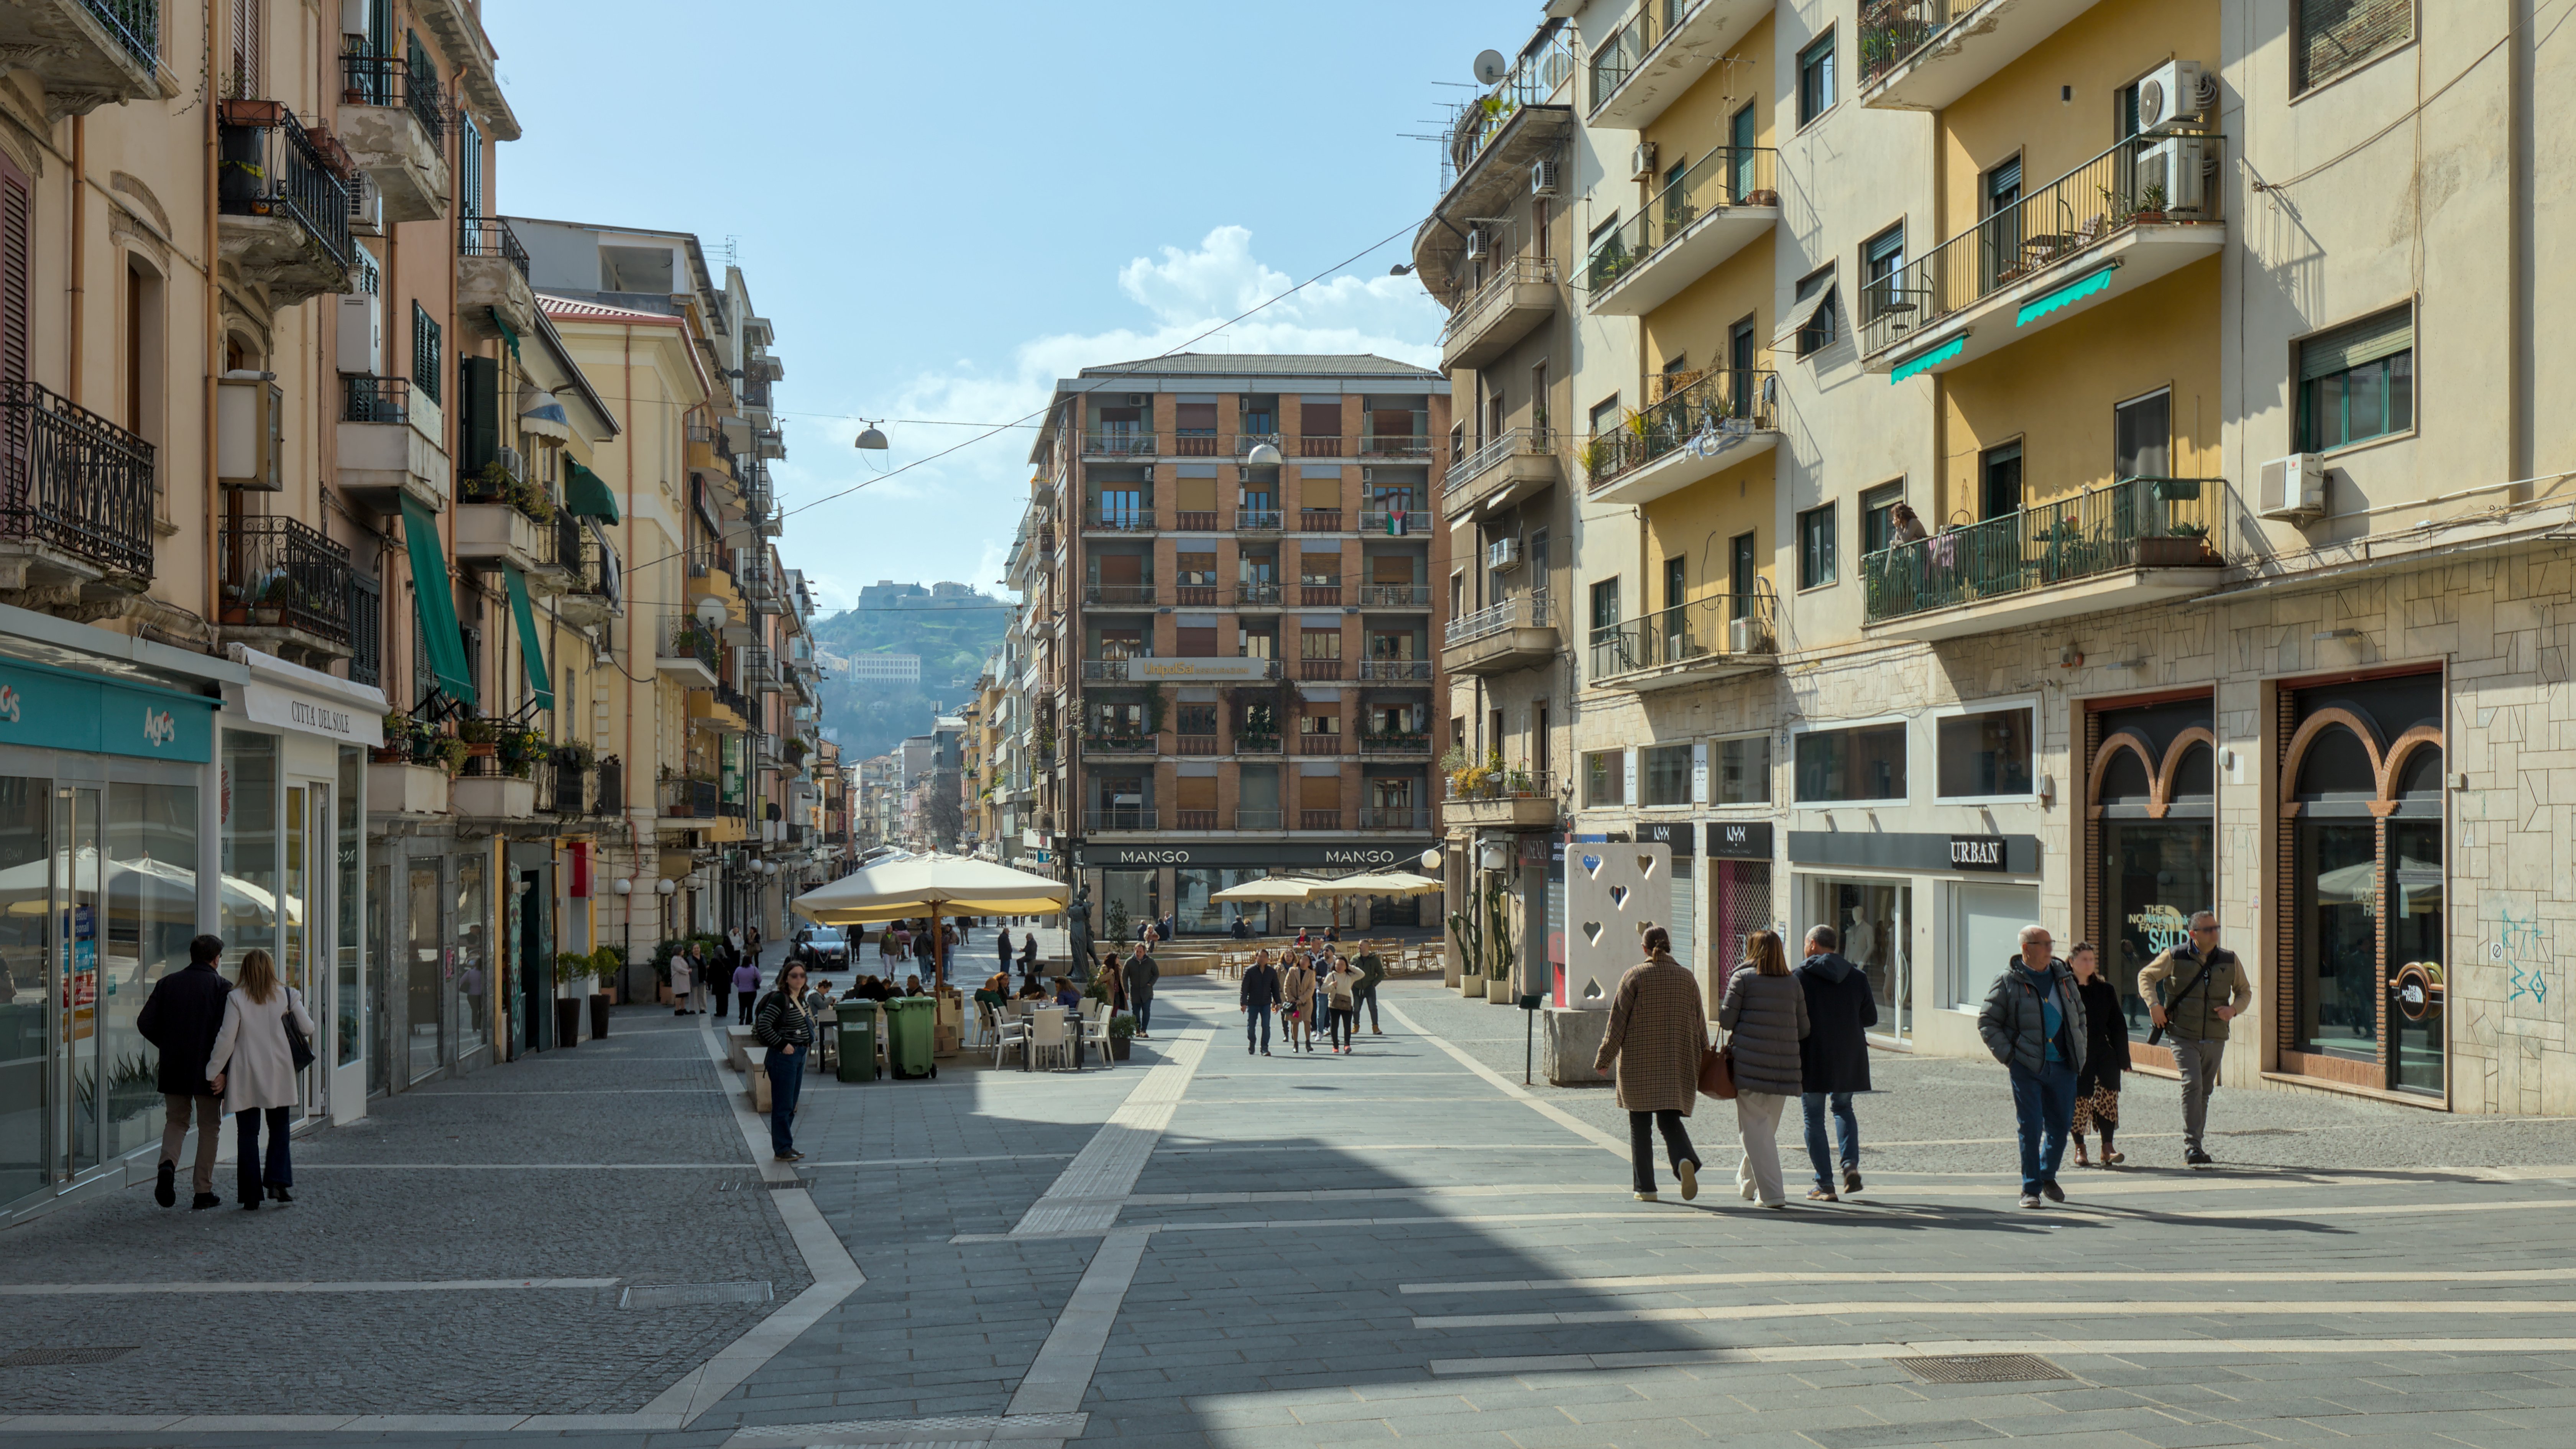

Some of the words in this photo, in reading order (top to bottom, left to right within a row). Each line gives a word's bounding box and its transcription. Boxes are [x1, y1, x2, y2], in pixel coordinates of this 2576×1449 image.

[1144, 662, 1194, 678] UnipolSai
[0, 684, 20, 723] os
[144, 706, 174, 747] Agos
[319, 708, 332, 729] DEL
[333, 712, 350, 733] SOLE
[1654, 826, 1669, 841] NYX
[1727, 826, 1745, 842] NYX
[1121, 850, 1189, 863] MANGO
[1326, 850, 1394, 863] MANGO
[1523, 840, 1547, 859] COSENZA
[1574, 850, 1580, 860] 7
[1950, 841, 1999, 864] URBAN
[2144, 905, 2165, 914] THE
[2146, 913, 2162, 923] Never
[2180, 914, 2190, 926] hik
[2149, 928, 2191, 954] SALD
